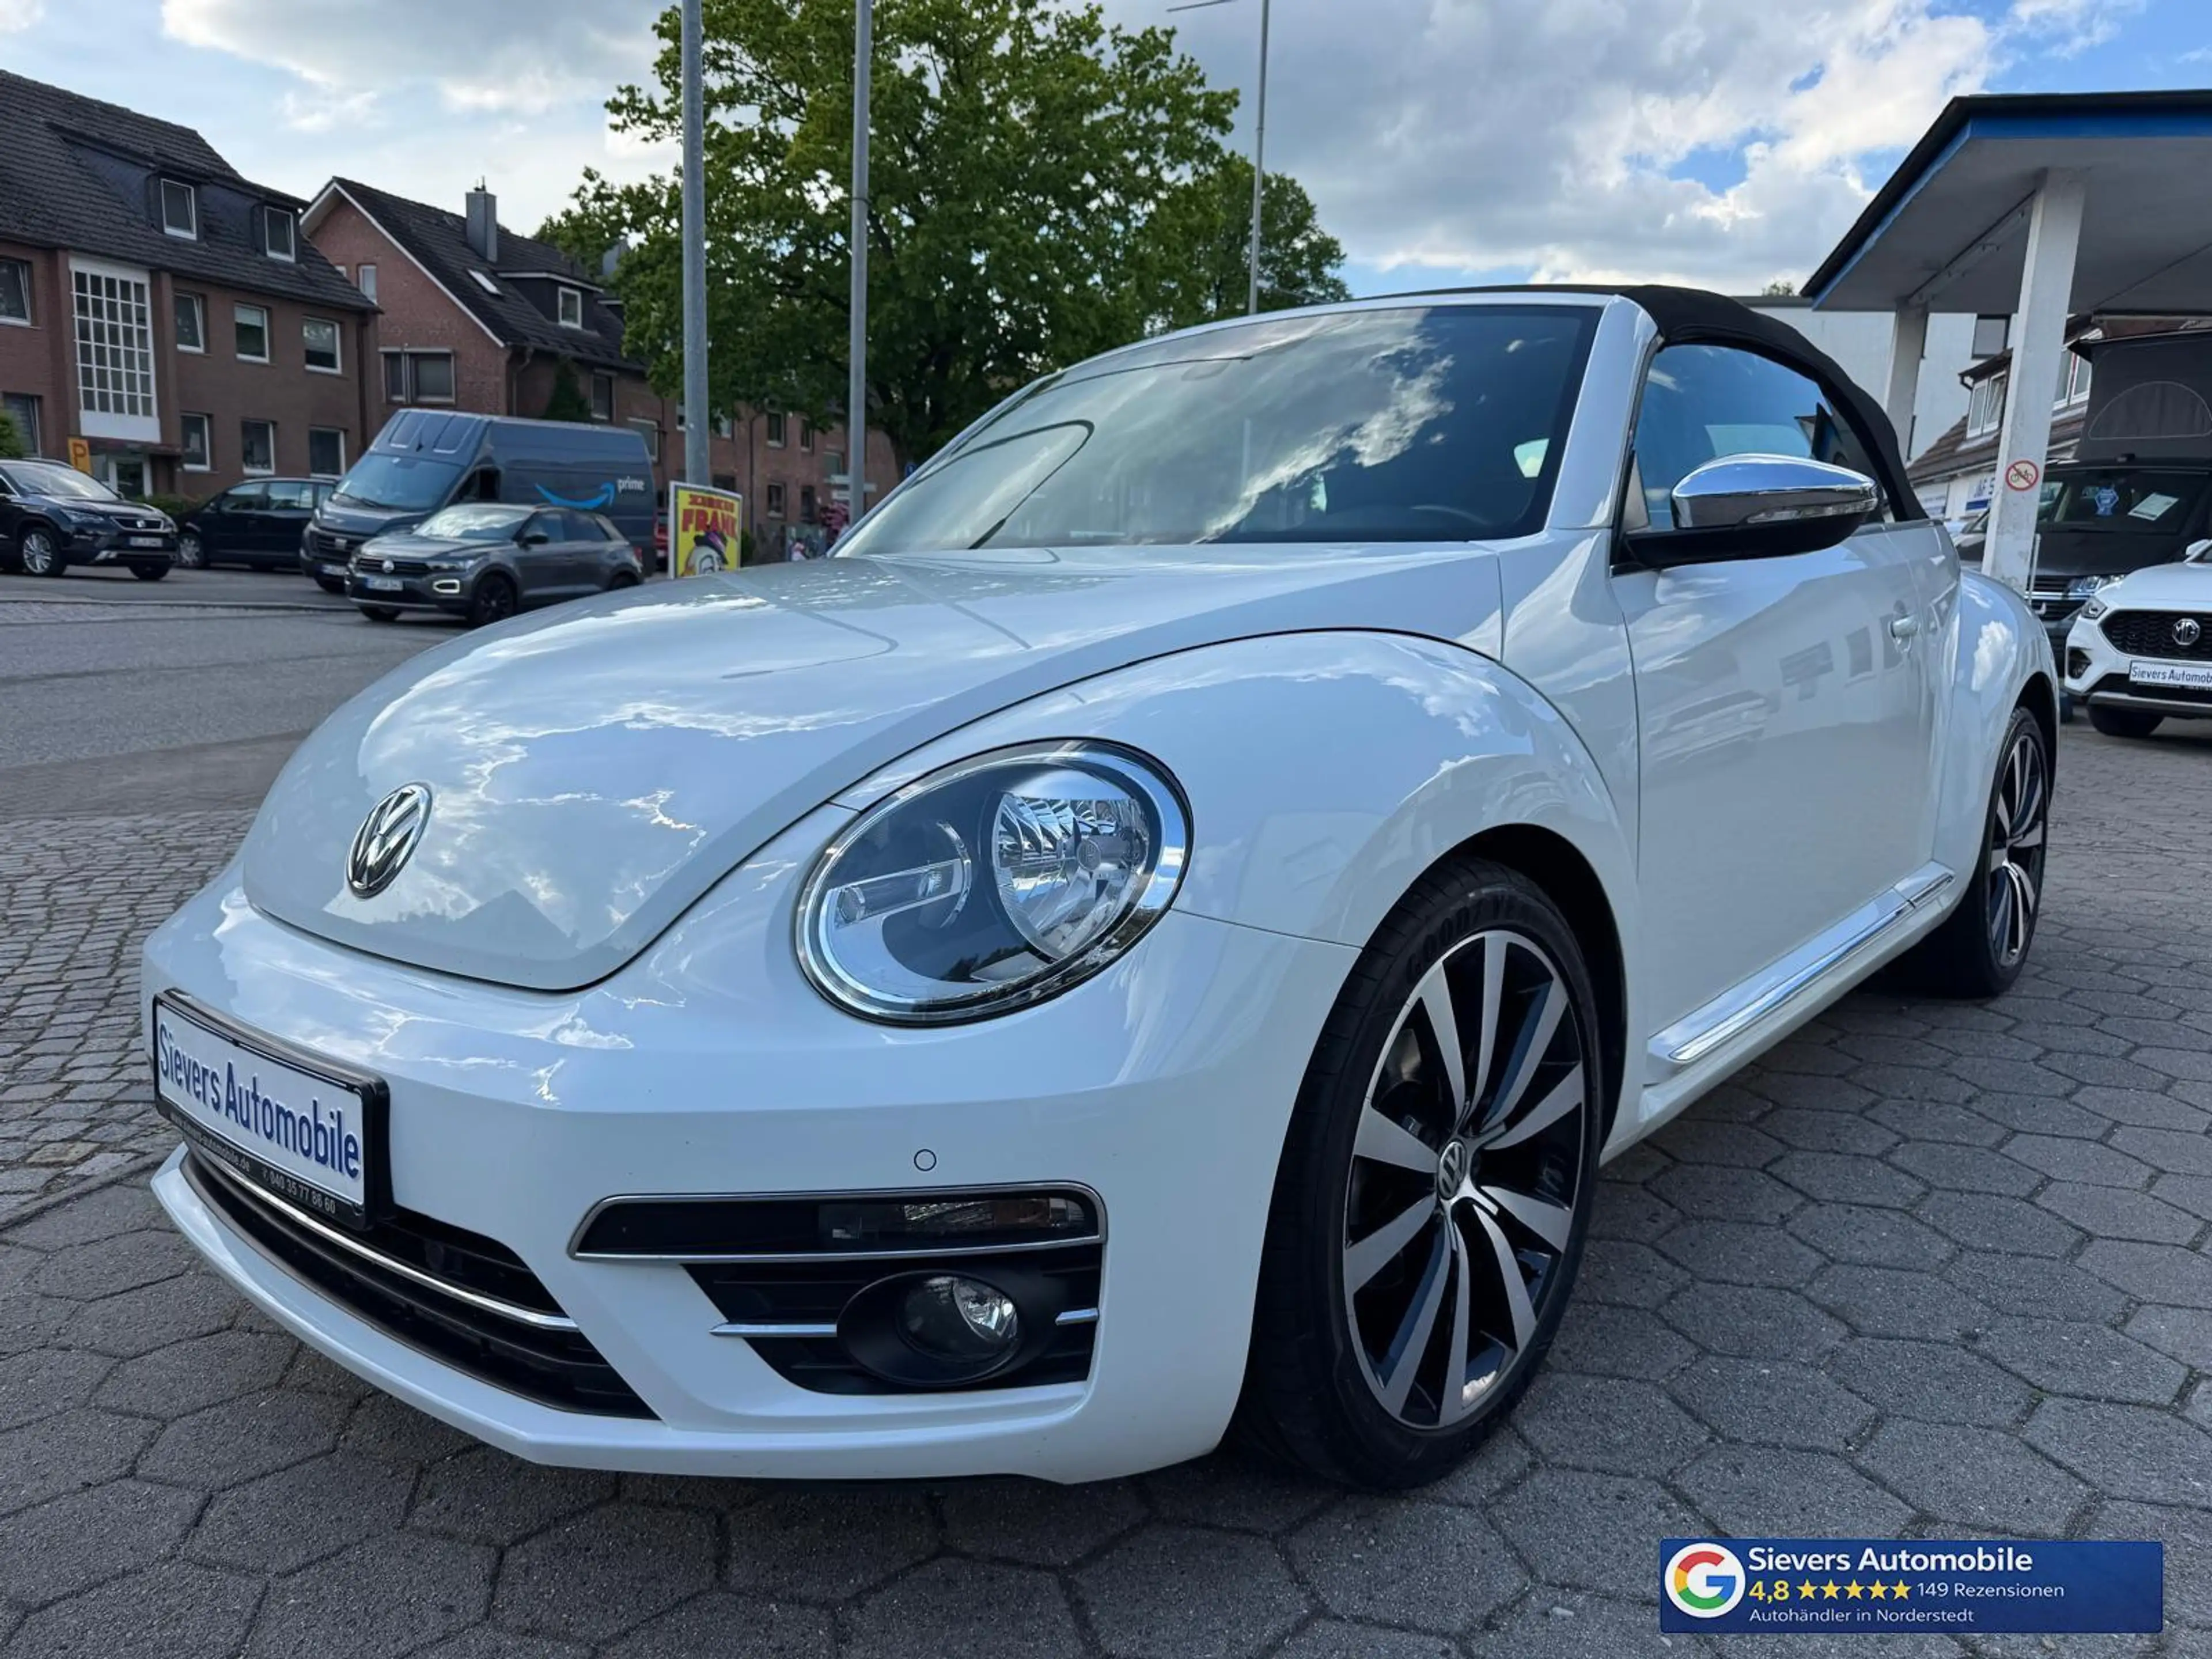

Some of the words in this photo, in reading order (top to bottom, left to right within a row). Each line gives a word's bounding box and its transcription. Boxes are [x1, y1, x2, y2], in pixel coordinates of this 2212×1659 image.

[618, 476, 645, 494] prime
[2131, 666, 2167, 680] Sievers
[160, 1023, 221, 1112] Sievers
[225, 1061, 359, 1179] Automobile
[286, 1179, 297, 1196] 35
[298, 1184, 309, 1202] 77
[324, 1196, 336, 1214] 60
